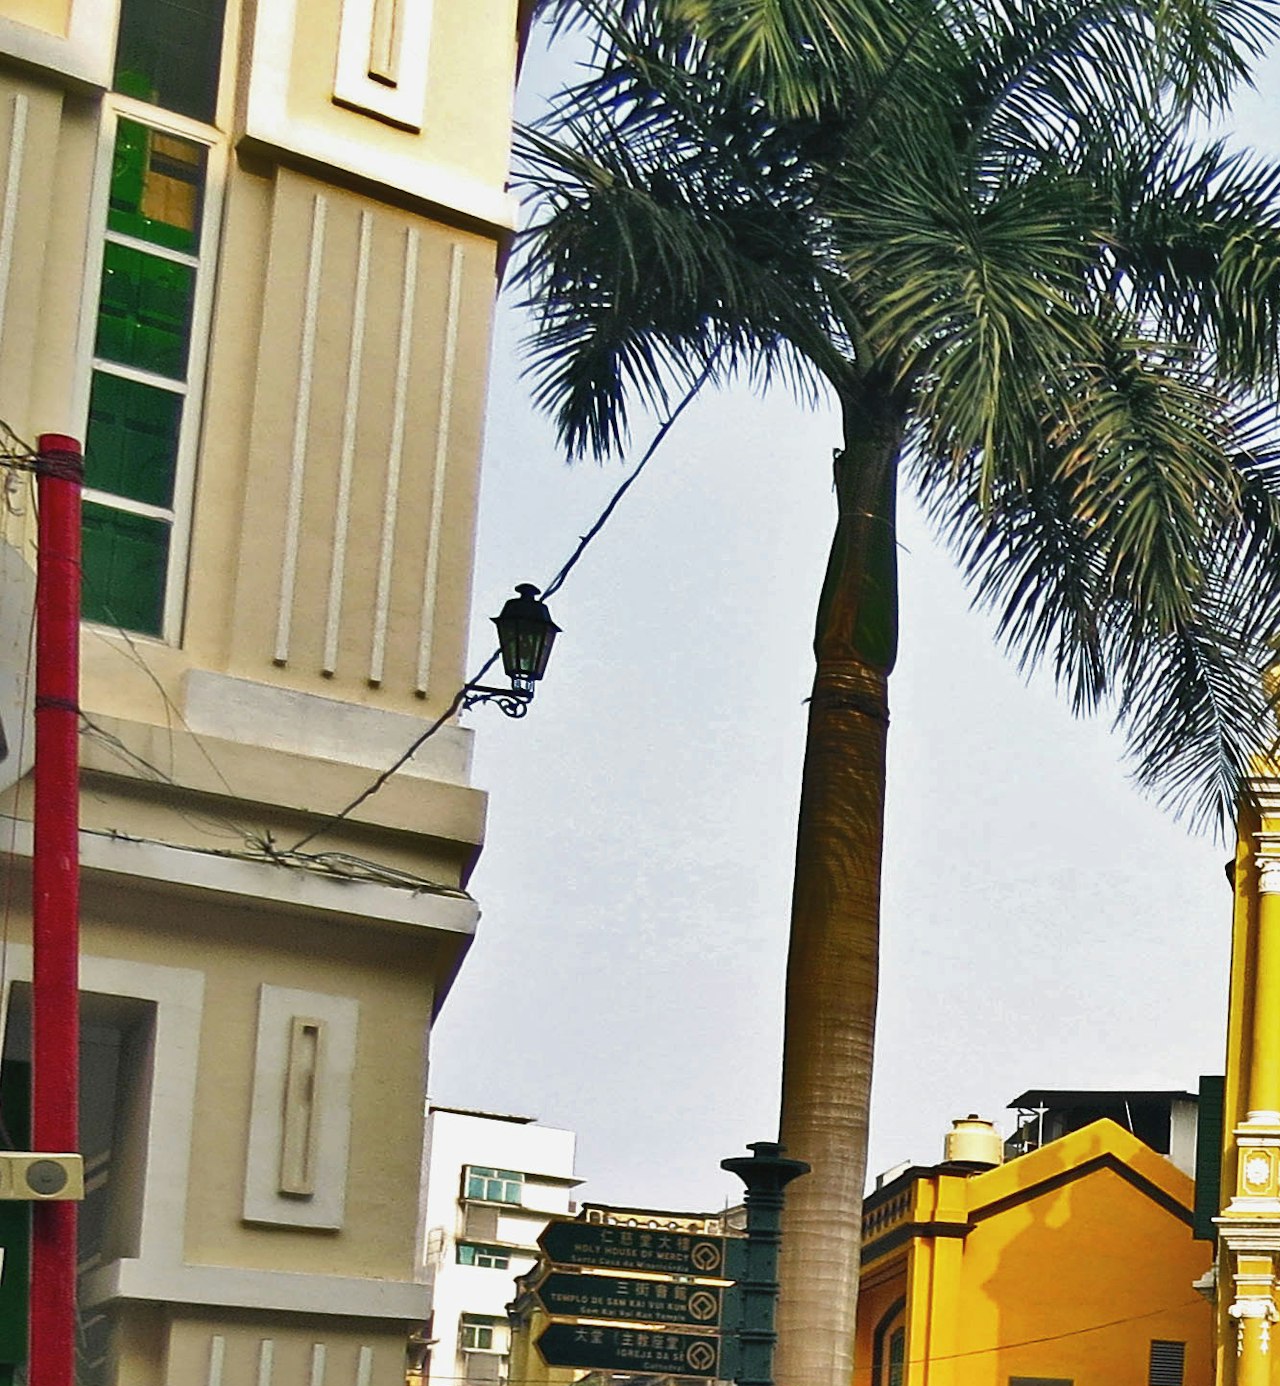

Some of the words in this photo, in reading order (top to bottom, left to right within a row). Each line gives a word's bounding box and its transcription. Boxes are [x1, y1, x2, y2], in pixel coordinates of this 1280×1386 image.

[574, 1243, 601, 1254] HOLY
[604, 1246, 638, 1258] HOUSE
[640, 1249, 654, 1259] OF
[656, 1251, 690, 1262] MERCY
[550, 1293, 589, 1304] TEMPLO
[591, 1296, 604, 1305] DE
[606, 1297, 627, 1306] SAM
[628, 1299, 646, 1308] KAI
[616, 1348, 654, 1361] IGREJA
[655, 1351, 671, 1361] DA
